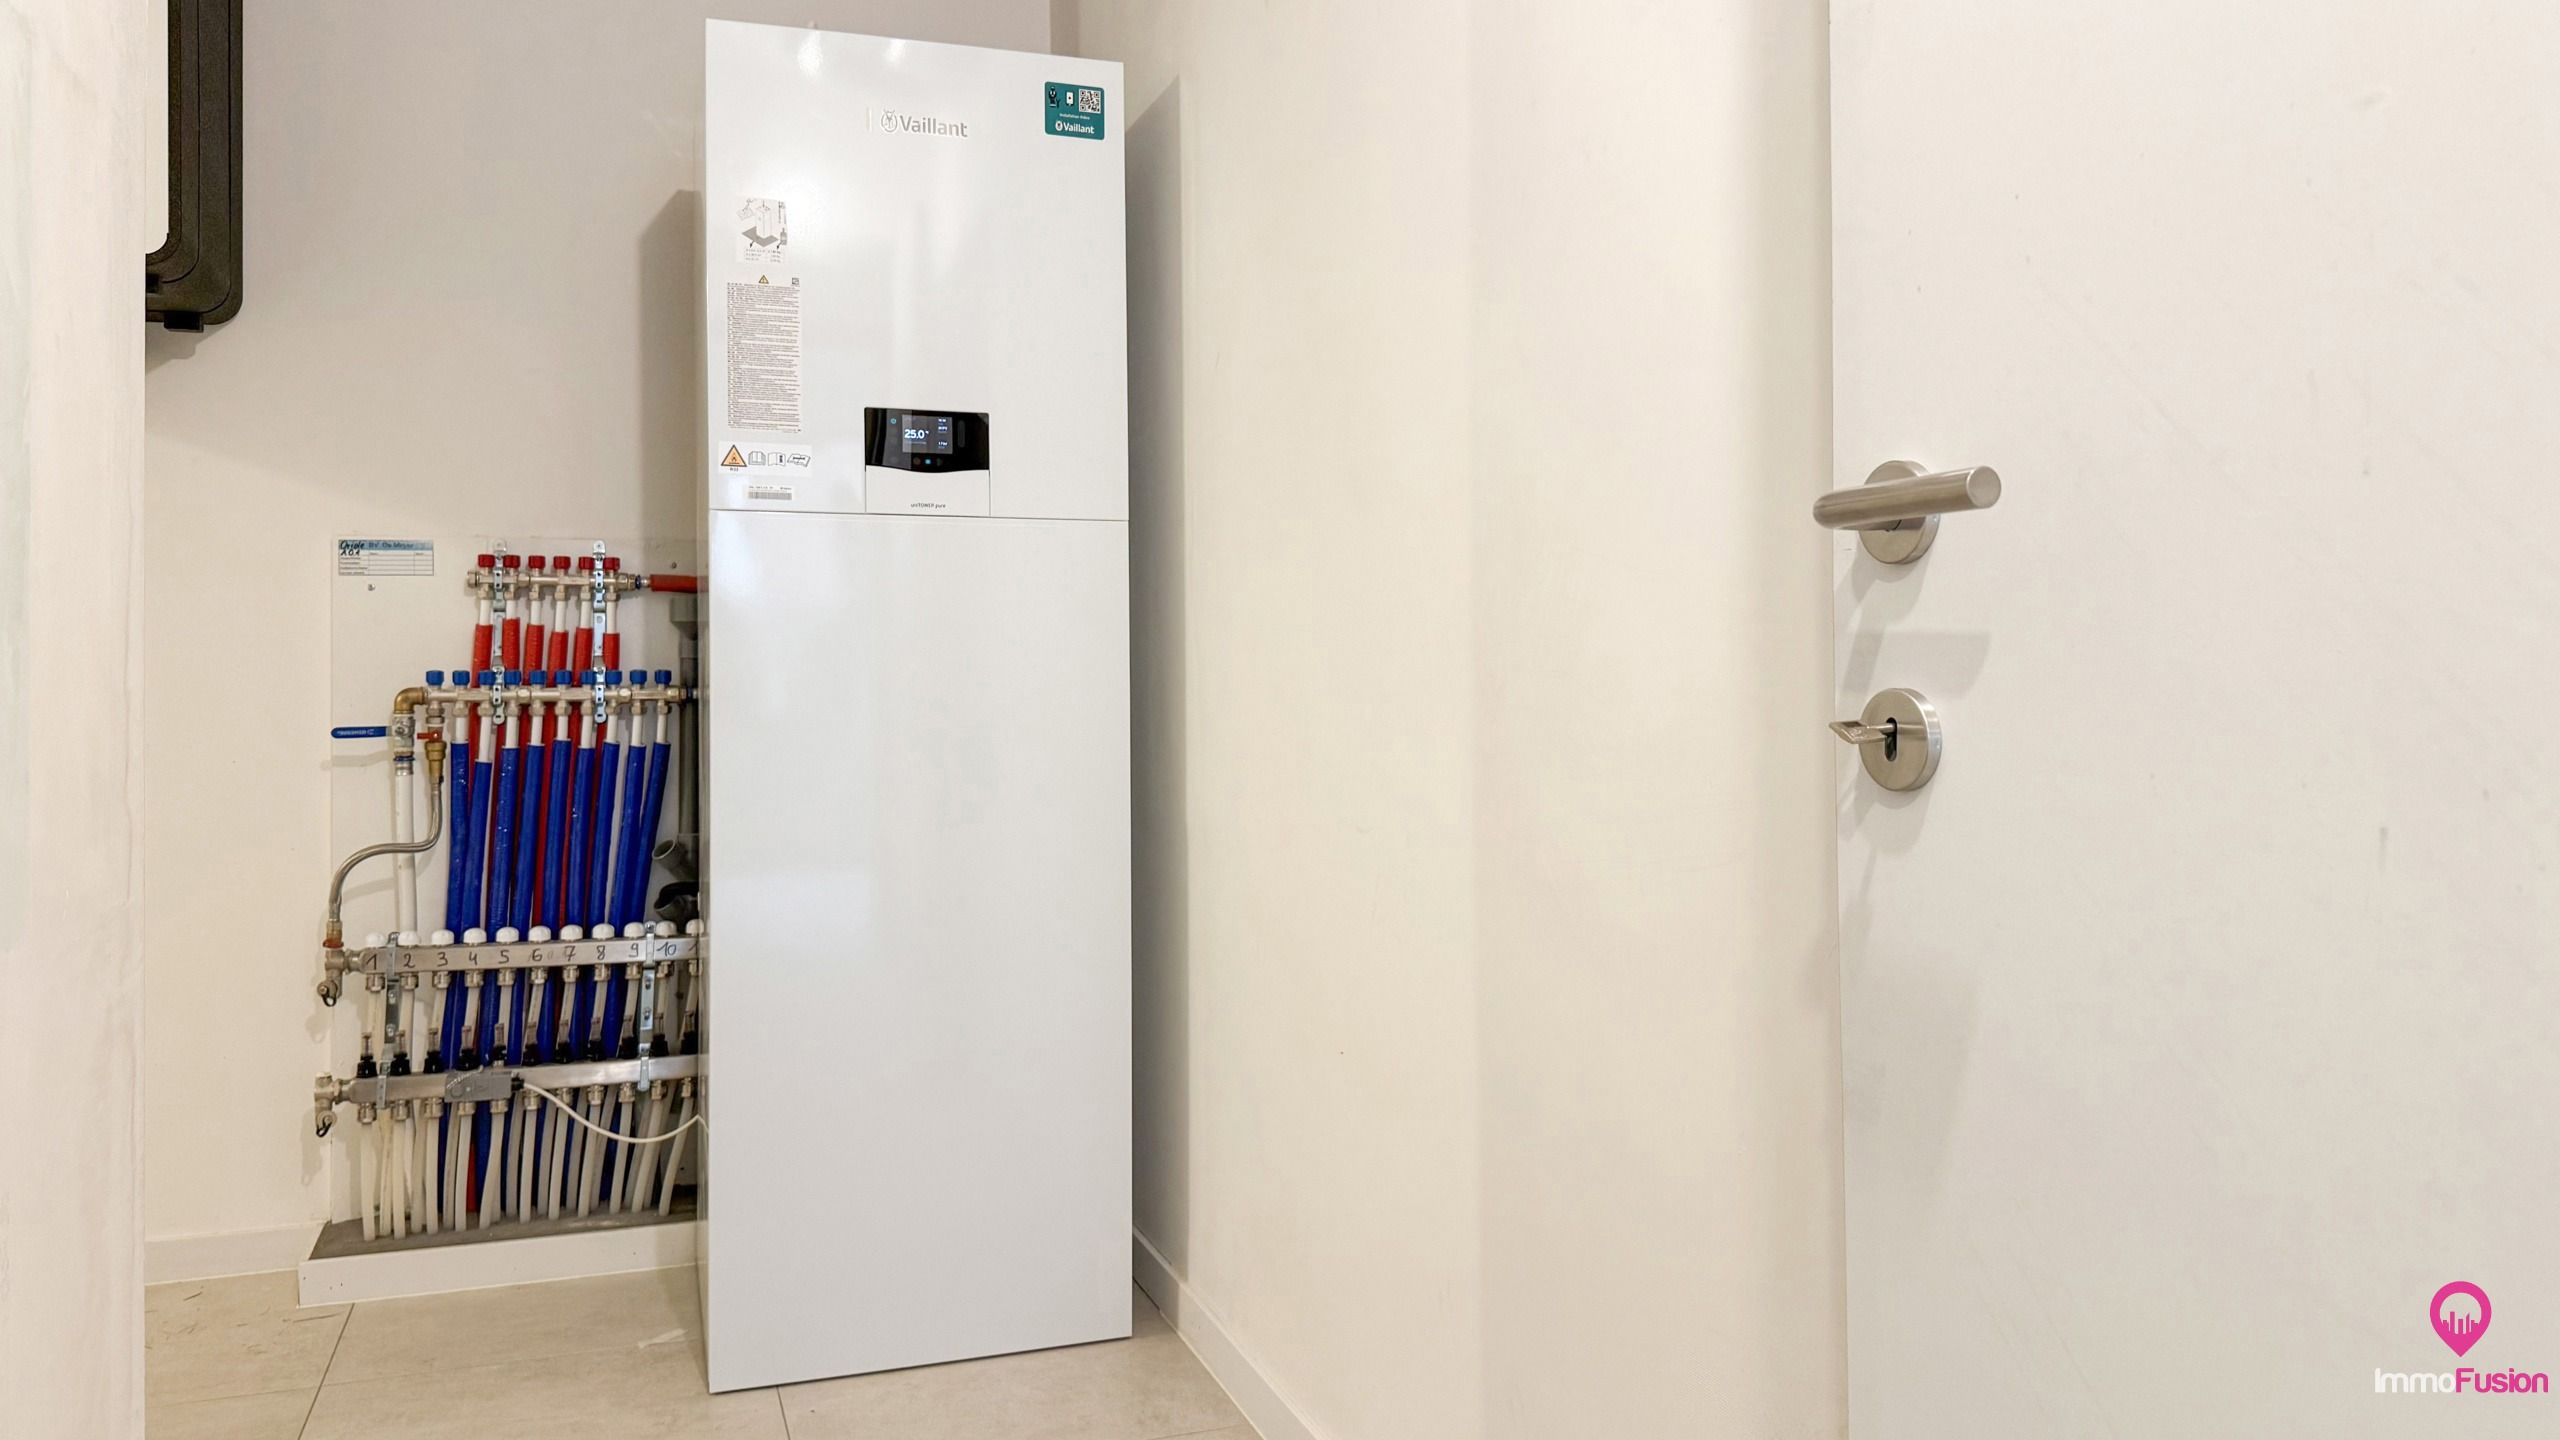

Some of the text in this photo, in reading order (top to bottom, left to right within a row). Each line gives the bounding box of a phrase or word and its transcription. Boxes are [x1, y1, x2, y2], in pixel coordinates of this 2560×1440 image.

[899, 115, 968, 137] Vaillant
[1063, 121, 1095, 134] Vaillant
[366, 953, 378, 971] 1
[403, 952, 416, 969] 2
[436, 951, 449, 968] 3
[468, 951, 478, 966] 4
[498, 948, 510, 965] 5
[531, 948, 543, 962] 6
[563, 945, 577, 963] 7
[596, 944, 606, 961] 8
[628, 942, 640, 958] 9
[655, 940, 677, 957] 10
